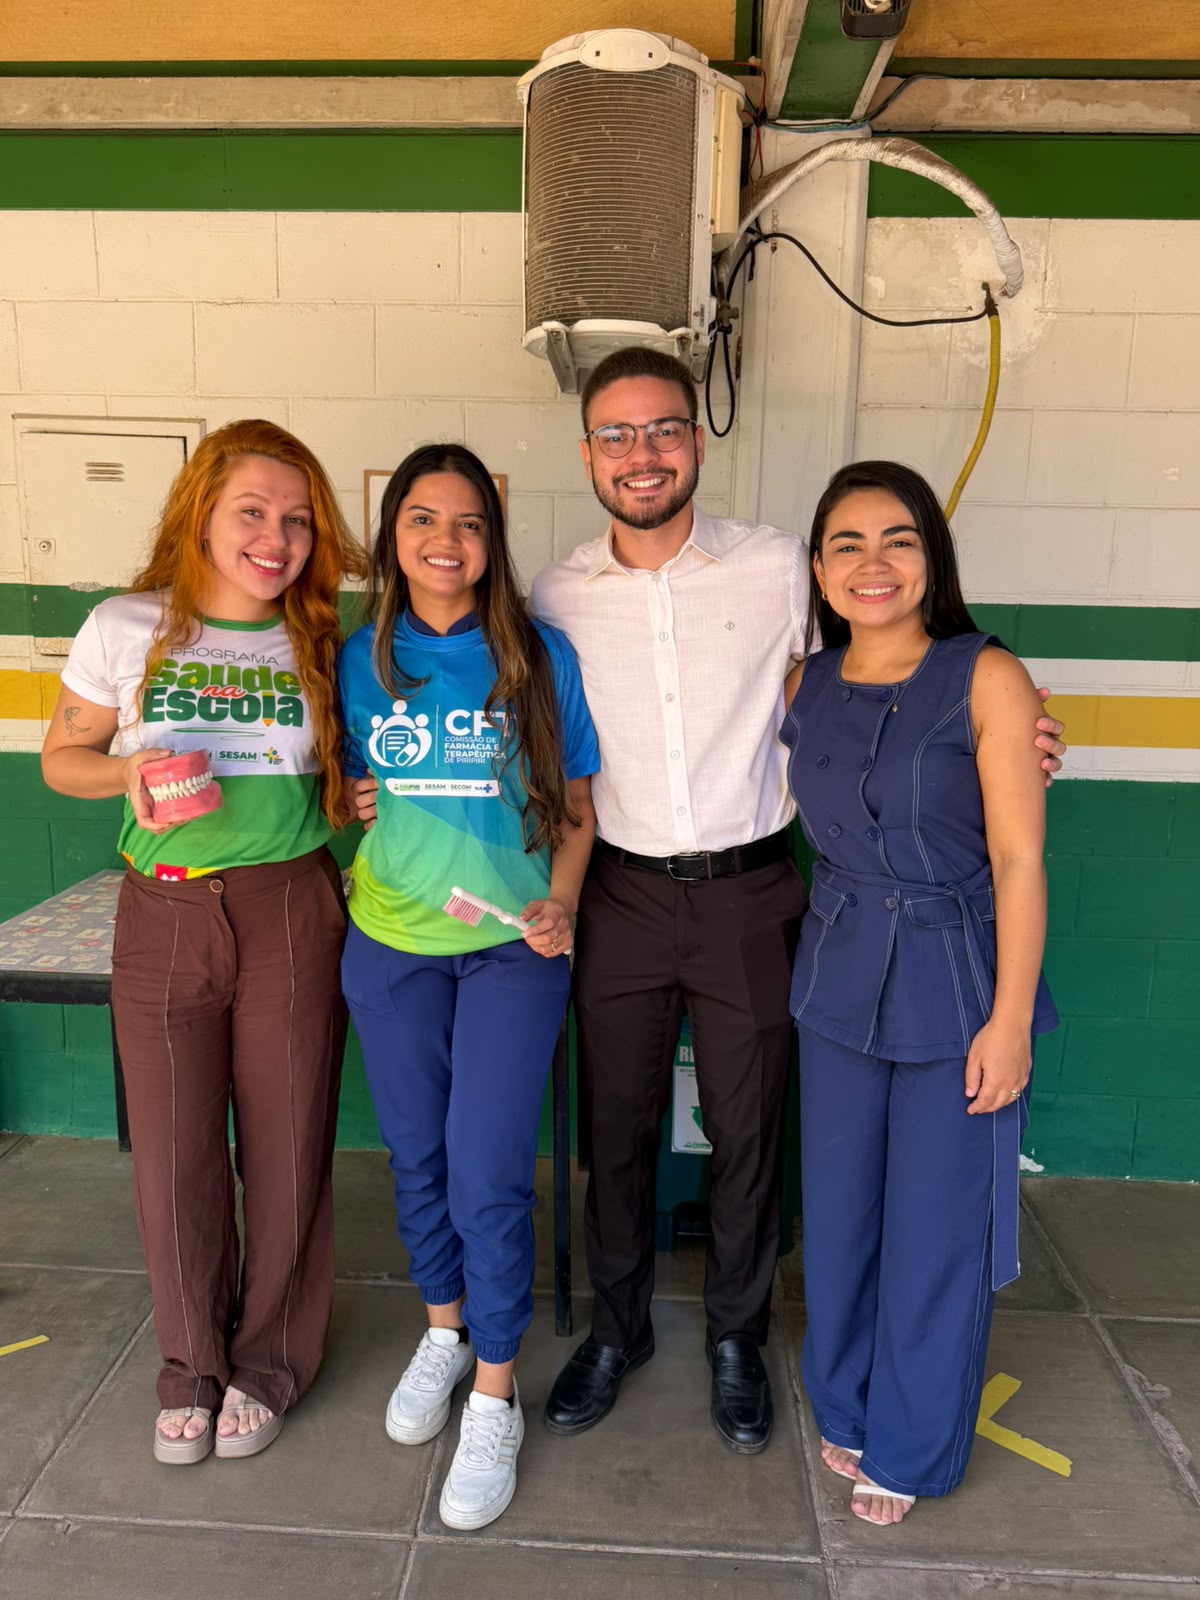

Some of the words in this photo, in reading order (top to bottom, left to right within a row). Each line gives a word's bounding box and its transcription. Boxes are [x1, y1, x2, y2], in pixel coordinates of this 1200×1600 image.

[170, 647, 279, 666] PROGRAMA
[201, 685, 247, 699] na
[444, 735, 485, 743] COMISSÃO
[485, 736, 497, 744] DE
[444, 742, 492, 751] FARMÁCIA
[219, 750, 257, 761] SESAM
